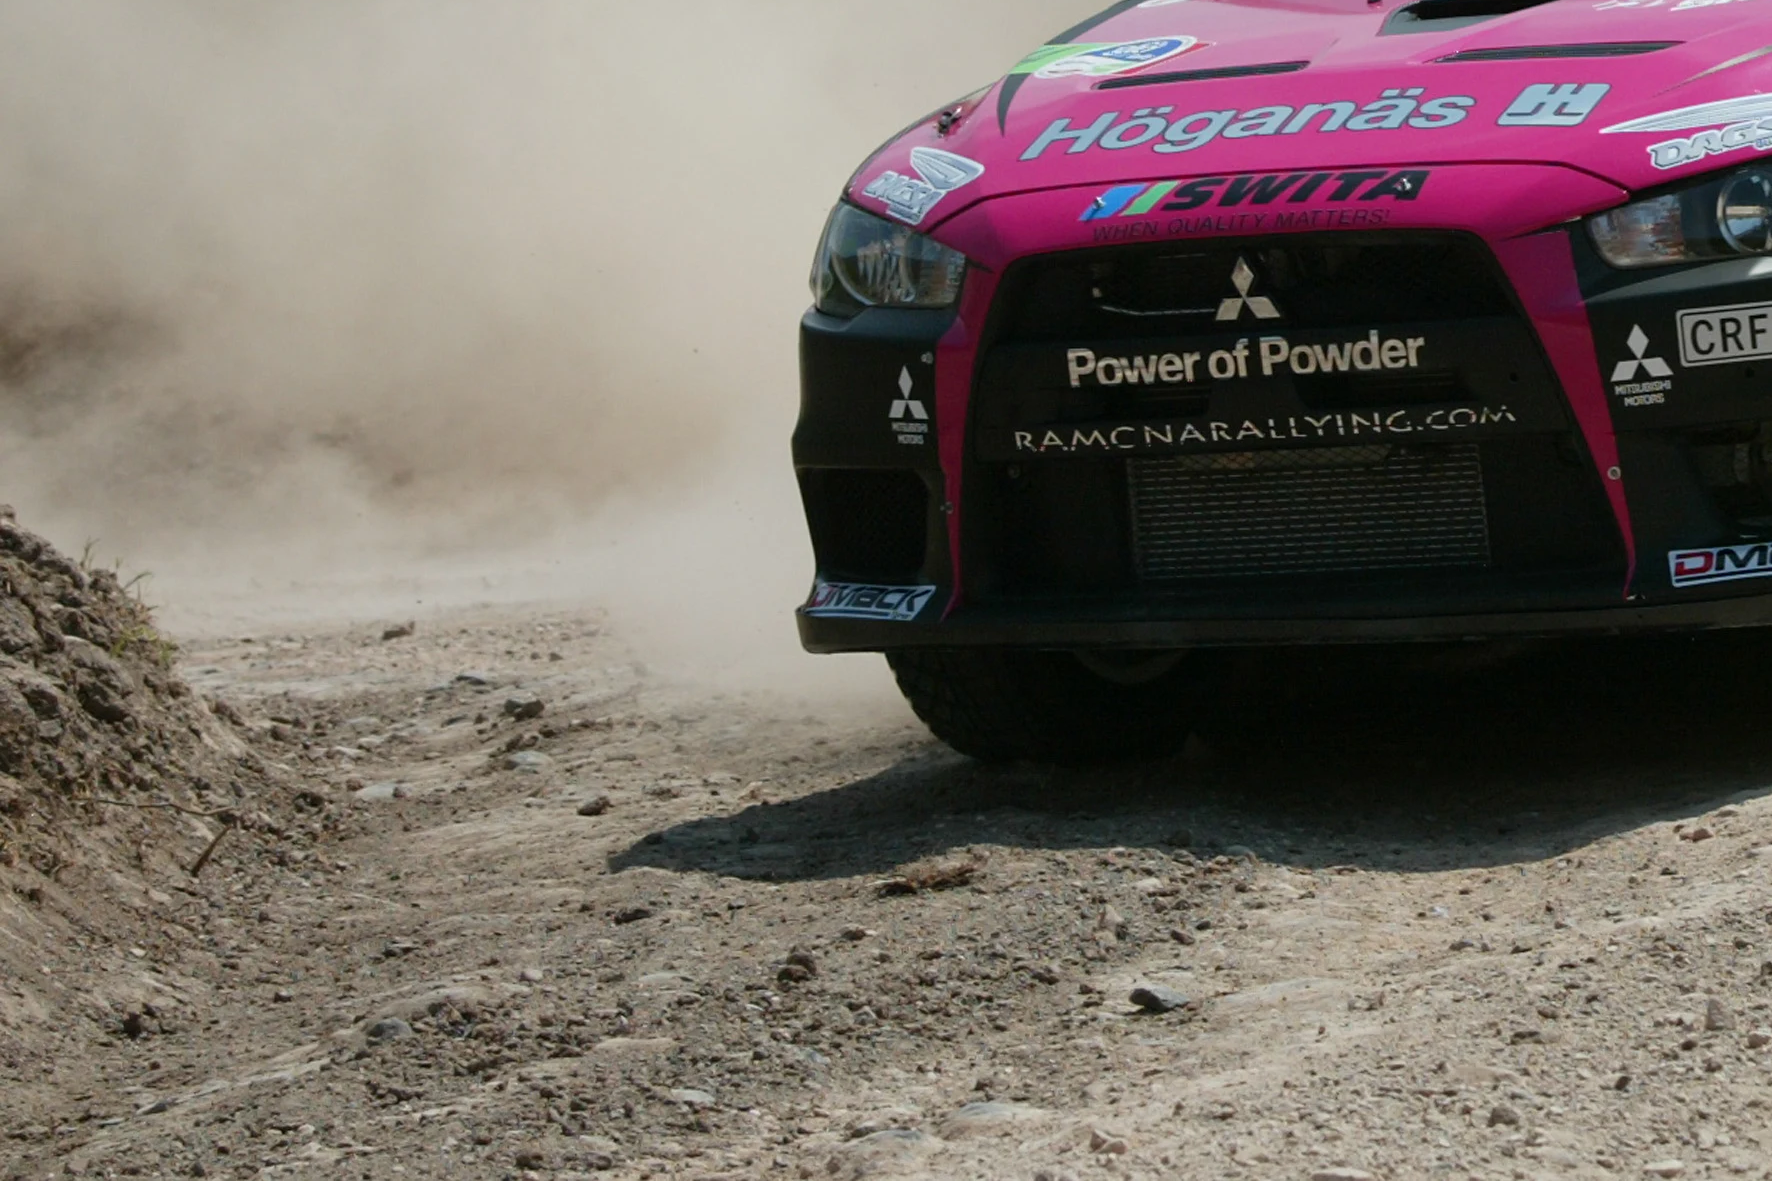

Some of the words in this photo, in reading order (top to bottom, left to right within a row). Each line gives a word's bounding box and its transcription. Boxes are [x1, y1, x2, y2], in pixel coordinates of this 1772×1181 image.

[1019, 87, 1475, 161] Höganäs
[1159, 170, 1431, 211] SWITA
[1092, 223, 1158, 243] WHEN
[1167, 215, 1265, 236] QUALITY
[1276, 208, 1392, 228] MATTERS!
[1690, 313, 1769, 356] CRF
[1067, 348, 1201, 388] Power
[1208, 338, 1250, 379] of
[1259, 330, 1425, 376] Powder
[1614, 379, 1672, 396] MITSUBISHI
[1624, 393, 1665, 407] MOTORS
[1014, 405, 1516, 453] RAMCNARALLYING.COM
